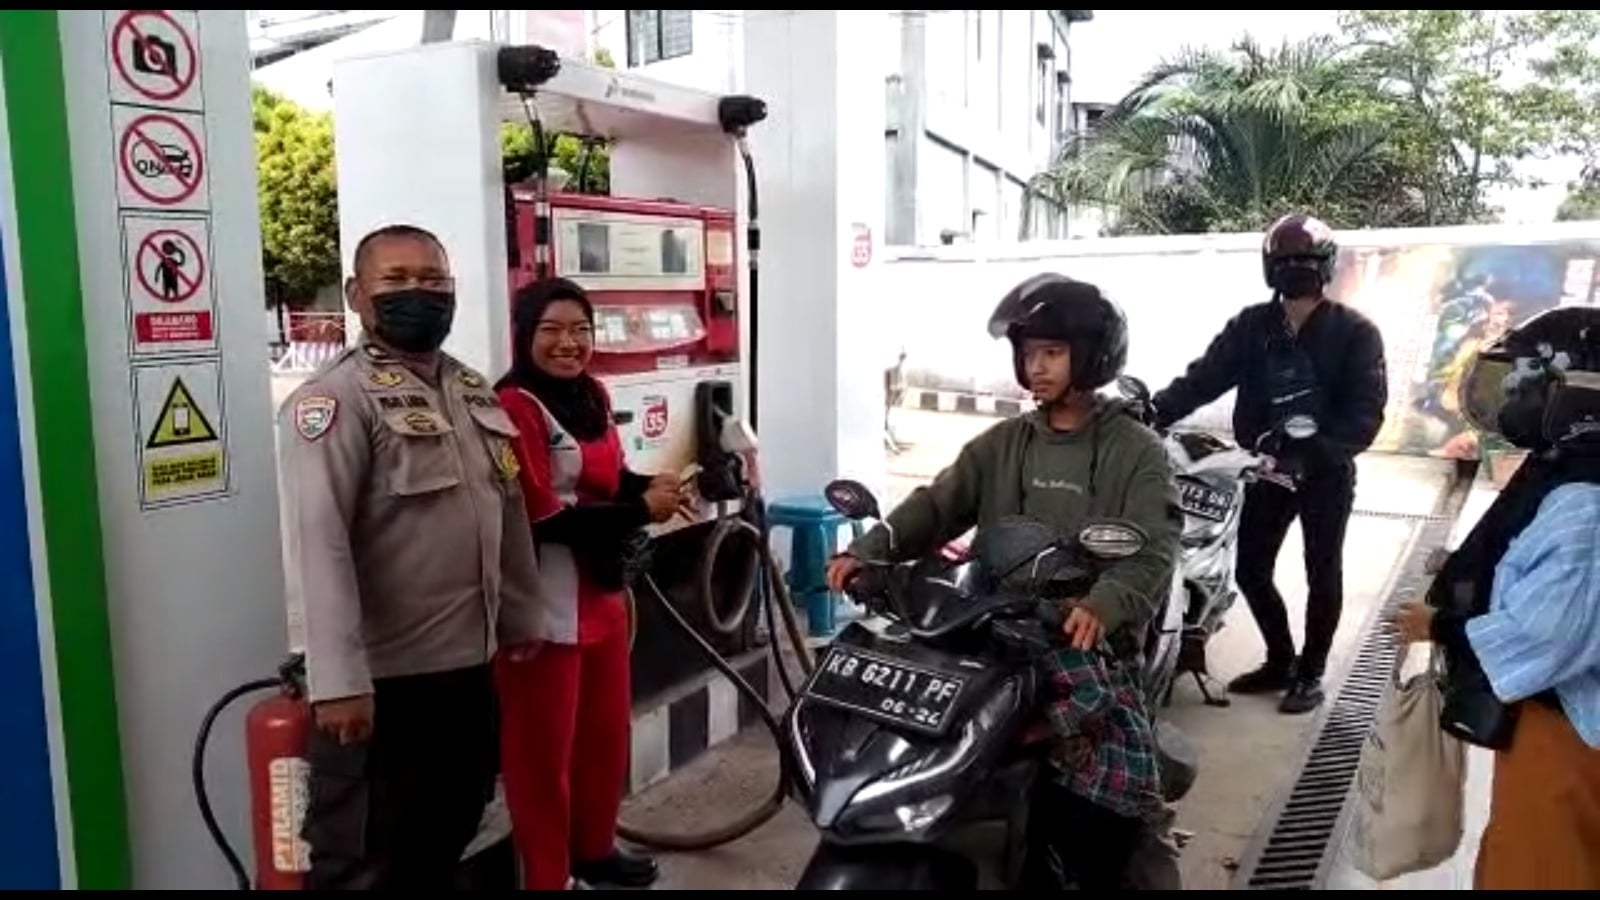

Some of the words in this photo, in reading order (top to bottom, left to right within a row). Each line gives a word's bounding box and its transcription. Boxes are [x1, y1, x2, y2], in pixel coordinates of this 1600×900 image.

[826, 653, 858, 677] KB
[861, 663, 916, 692] 6211
[924, 678, 956, 701] PF
[272, 759, 294, 869] PYRAMID
